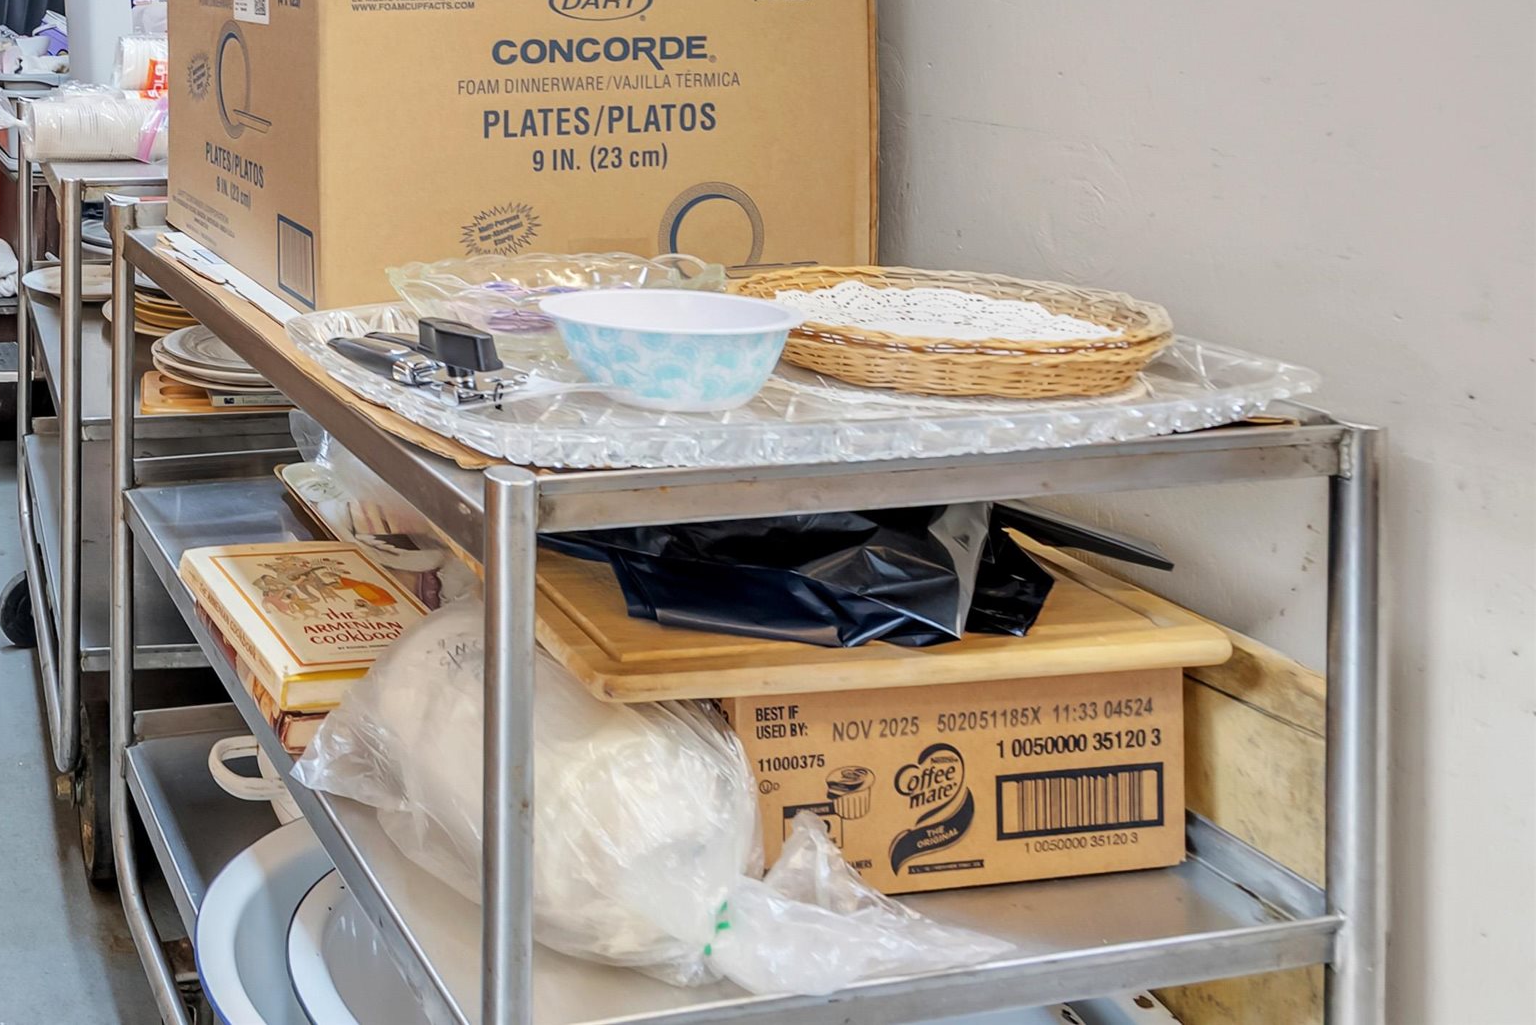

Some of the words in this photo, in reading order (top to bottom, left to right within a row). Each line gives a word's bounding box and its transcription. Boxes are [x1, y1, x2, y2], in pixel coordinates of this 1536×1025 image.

[351, 2, 475, 11] WWW.FOAMCUPFACTS.COM
[492, 35, 708, 71] CONCORDE
[458, 79, 500, 95] FOAM
[677, 69, 741, 88] TÉRMICA
[483, 102, 717, 139] PLATES/PLATOS
[532, 150, 544, 172] 9
[552, 149, 581, 171] IN.
[590, 145, 623, 173] (23
[630, 143, 668, 170] cm)
[303, 619, 403, 634] ARMENIAN
[755, 706, 784, 722] BEST
[788, 705, 799, 720] IF
[832, 720, 873, 742] NOV
[878, 716, 920, 739] 2025
[937, 706, 1042, 733] 502051185X
[1053, 701, 1098, 724] 11:33
[1104, 697, 1153, 720] 04524
[756, 724, 786, 740] USED
[790, 722, 808, 737] BY:
[996, 740, 1006, 758] 1
[1012, 733, 1088, 757] 0050000
[1092, 729, 1146, 751] 35120
[1151, 728, 1162, 747] 3
[758, 754, 825, 772] 11000375
[894, 763, 956, 797] Coffee
[909, 783, 953, 809] mate
[1024, 842, 1031, 853] 1
[1034, 835, 1088, 853] 0050000
[1090, 833, 1128, 847] 35120
[1130, 831, 1139, 844] 3
